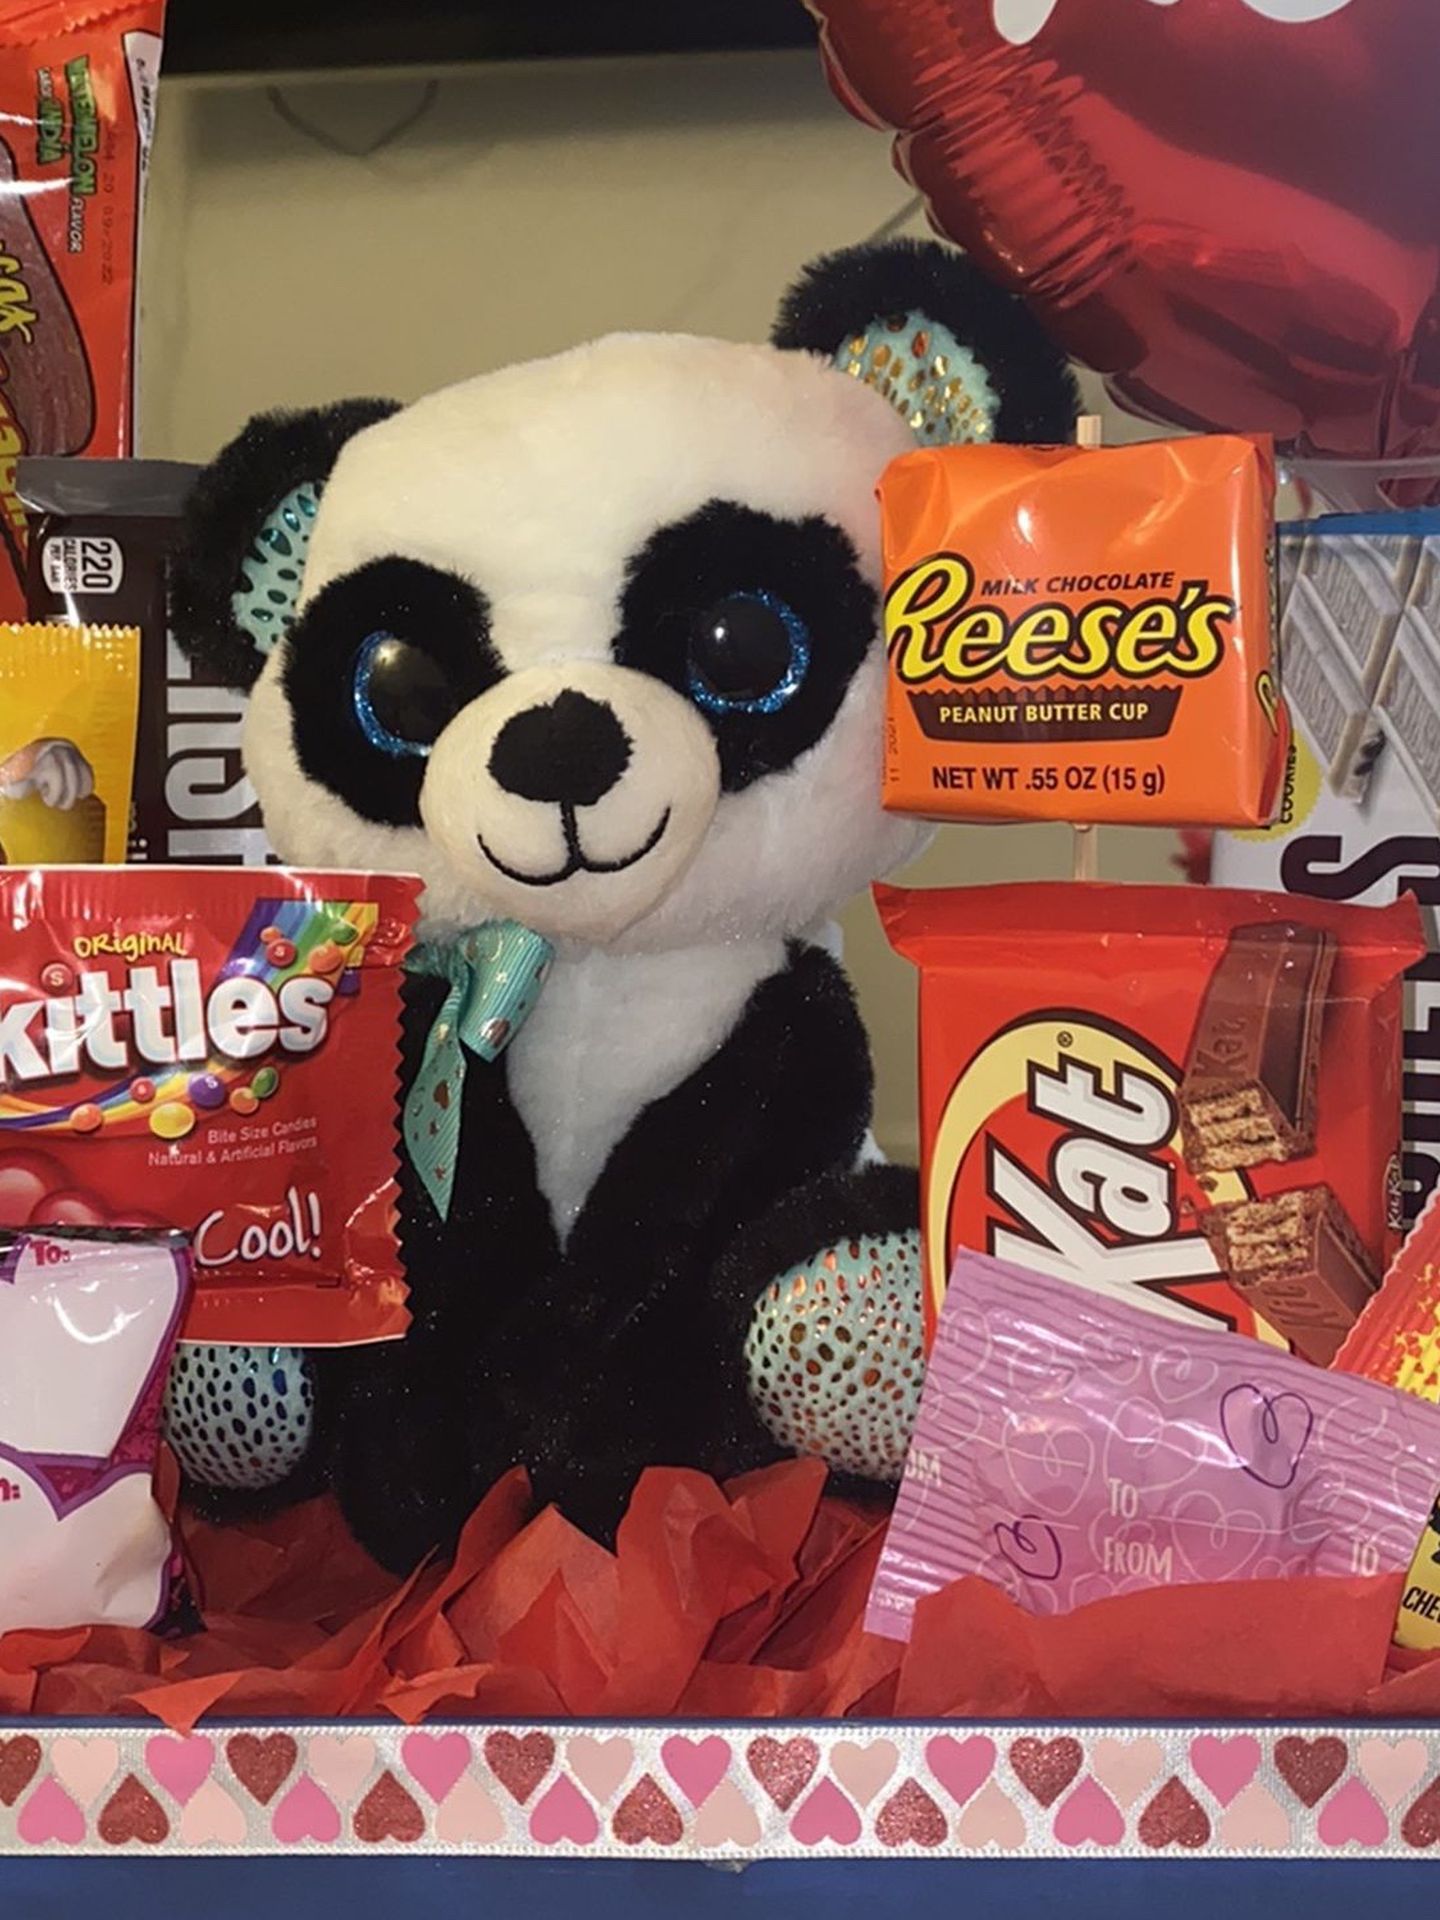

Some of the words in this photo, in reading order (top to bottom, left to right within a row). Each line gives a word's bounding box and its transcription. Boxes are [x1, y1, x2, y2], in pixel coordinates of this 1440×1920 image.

[65, 55, 98, 197] WATERMELON
[68, 197, 86, 253] FLAVOR
[63, 539, 78, 592] CALORIES
[81, 540, 113, 590] 220
[980, 576, 1039, 597] MILK
[1046, 571, 1175, 595] CHOCOLATE
[884, 550, 1238, 684] Reese's
[938, 704, 1018, 725] PEANUT
[1025, 703, 1102, 723] BUTTER
[1109, 702, 1150, 722] CUP
[931, 767, 978, 791] NET
[983, 767, 1020, 791] WT
[1024, 767, 1059, 790] .55
[1065, 766, 1098, 790] OZ
[1102, 765, 1137, 793] (15
[1141, 765, 1166, 795] g)
[0, 957, 335, 1084] kittles
[147, 1149, 202, 1167] Natural
[205, 1151, 217, 1165] &
[219, 1144, 276, 1163] Artificial
[277, 1135, 318, 1155] Flavors
[207, 1129, 237, 1145] Bite
[239, 1125, 269, 1142] Size
[271, 1115, 318, 1137] Candies
[193, 1186, 322, 1266] Cool!
[28, 1238, 71, 1266] To:
[1107, 1477, 1139, 1519] TO
[1102, 1536, 1173, 1582] FROM
[1348, 1536, 1380, 1576] TO
